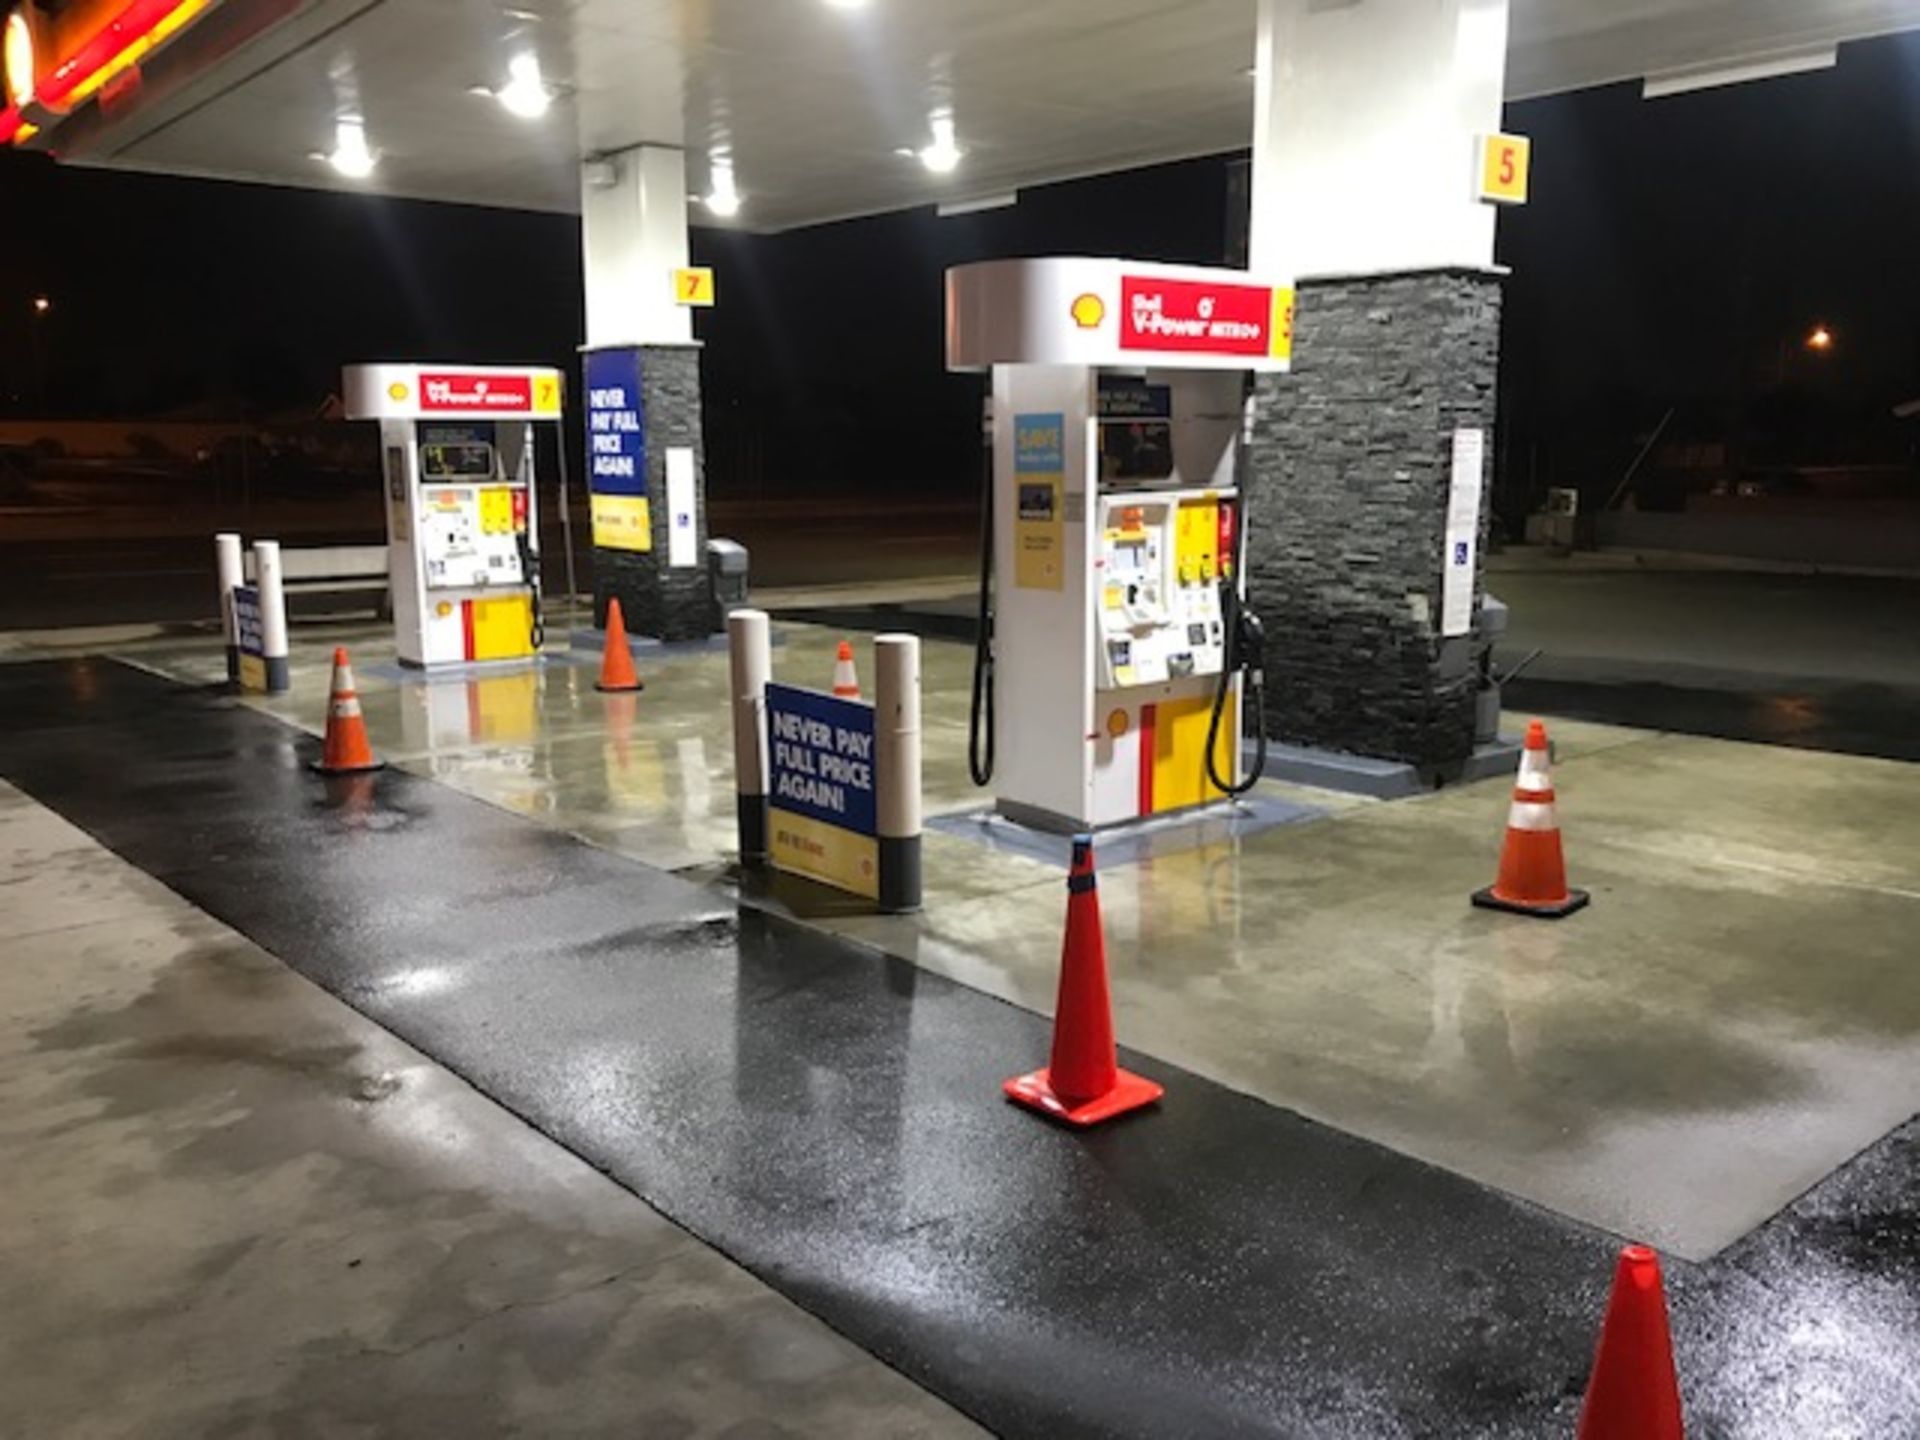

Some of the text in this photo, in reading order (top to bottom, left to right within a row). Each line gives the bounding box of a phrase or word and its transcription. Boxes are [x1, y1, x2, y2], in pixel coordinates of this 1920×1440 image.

[1499, 147, 1515, 184] 5
[686, 275, 700, 297] 7
[1132, 311, 1209, 336] V-Power
[541, 383, 553, 403] 7
[590, 388, 626, 408] NEVER
[591, 411, 640, 431] PAY FULL
[593, 434, 622, 454] PRICE
[773, 710, 873, 759] NEVER PAY
[775, 742, 872, 790] FULL PRICE
[776, 772, 846, 813] AGAIN!
